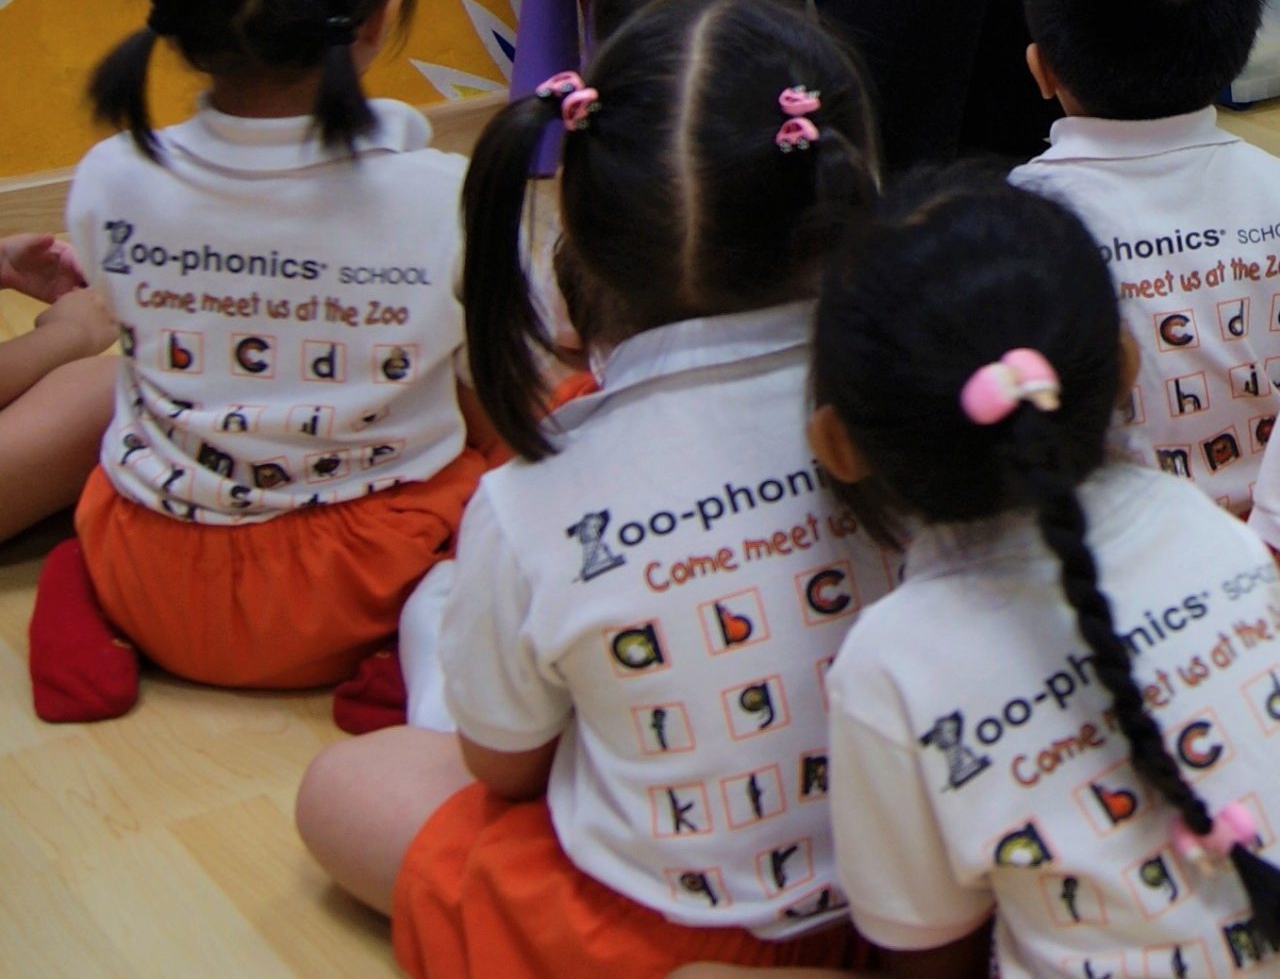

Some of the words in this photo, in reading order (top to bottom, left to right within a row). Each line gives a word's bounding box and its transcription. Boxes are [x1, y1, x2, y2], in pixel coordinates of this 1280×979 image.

[339, 265, 431, 286] SCHOOL
[1120, 270, 1174, 298] meet
[1180, 271, 1202, 292] us
[1206, 260, 1226, 287] at
[1230, 258, 1261, 281] the
[136, 282, 196, 315] Come
[202, 292, 260, 319] meet
[266, 296, 290, 320] us
[295, 295, 319, 321] at
[324, 299, 359, 327] the
[363, 301, 409, 326] Zoo
[1228, 300, 1245, 337] d
[168, 332, 194, 371] b
[312, 343, 336, 379] d
[382, 349, 411, 381] e
[1175, 379, 1201, 414] h
[645, 543, 739, 592] Come
[743, 513, 819, 562] meet
[613, 623, 663, 669] a
[714, 601, 752, 646] b
[652, 708, 665, 750] f
[740, 681, 775, 729] g
[1011, 723, 1104, 787] Come
[1178, 653, 1210, 688] us
[1210, 631, 1238, 670] at
[1232, 617, 1274, 650] the
[669, 788, 697, 833] k
[1089, 782, 1138, 826] b
[771, 844, 798, 888] r
[1139, 855, 1179, 903] g
